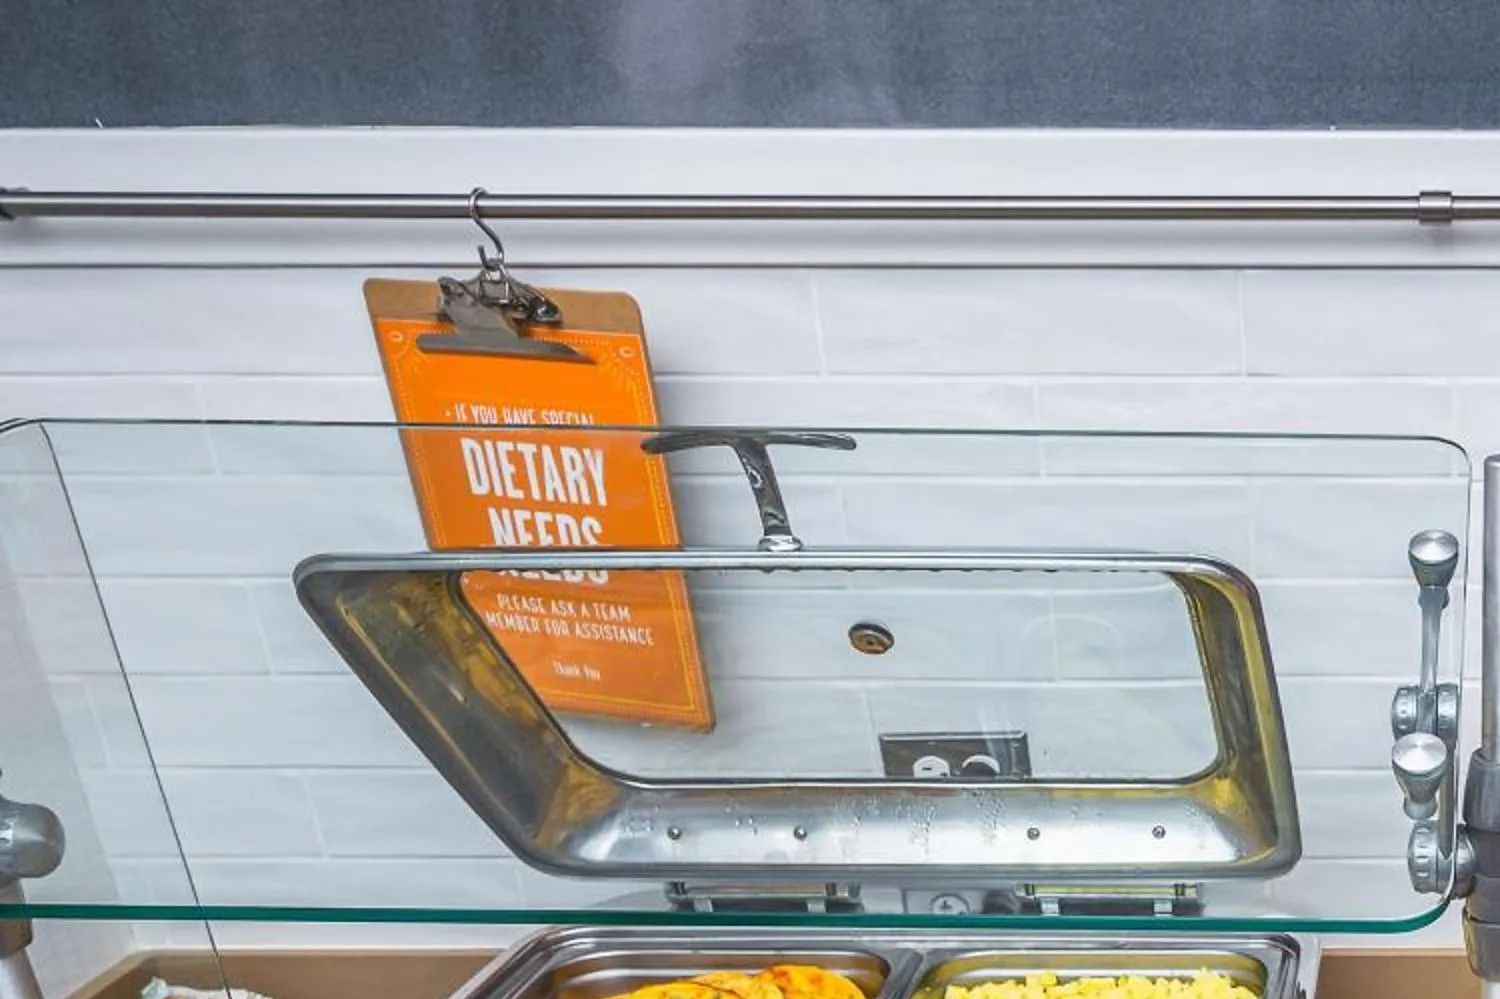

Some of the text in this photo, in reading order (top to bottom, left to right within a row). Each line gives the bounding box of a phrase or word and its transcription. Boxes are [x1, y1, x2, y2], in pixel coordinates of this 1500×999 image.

[471, 403, 498, 425] YOU
[460, 437, 608, 507] DIETARY
[487, 506, 609, 585] NEEDS
[497, 593, 631, 623] PLEASE ASK A TEAM
[485, 611, 656, 647] MEMBER FOR ASSISTANCE
